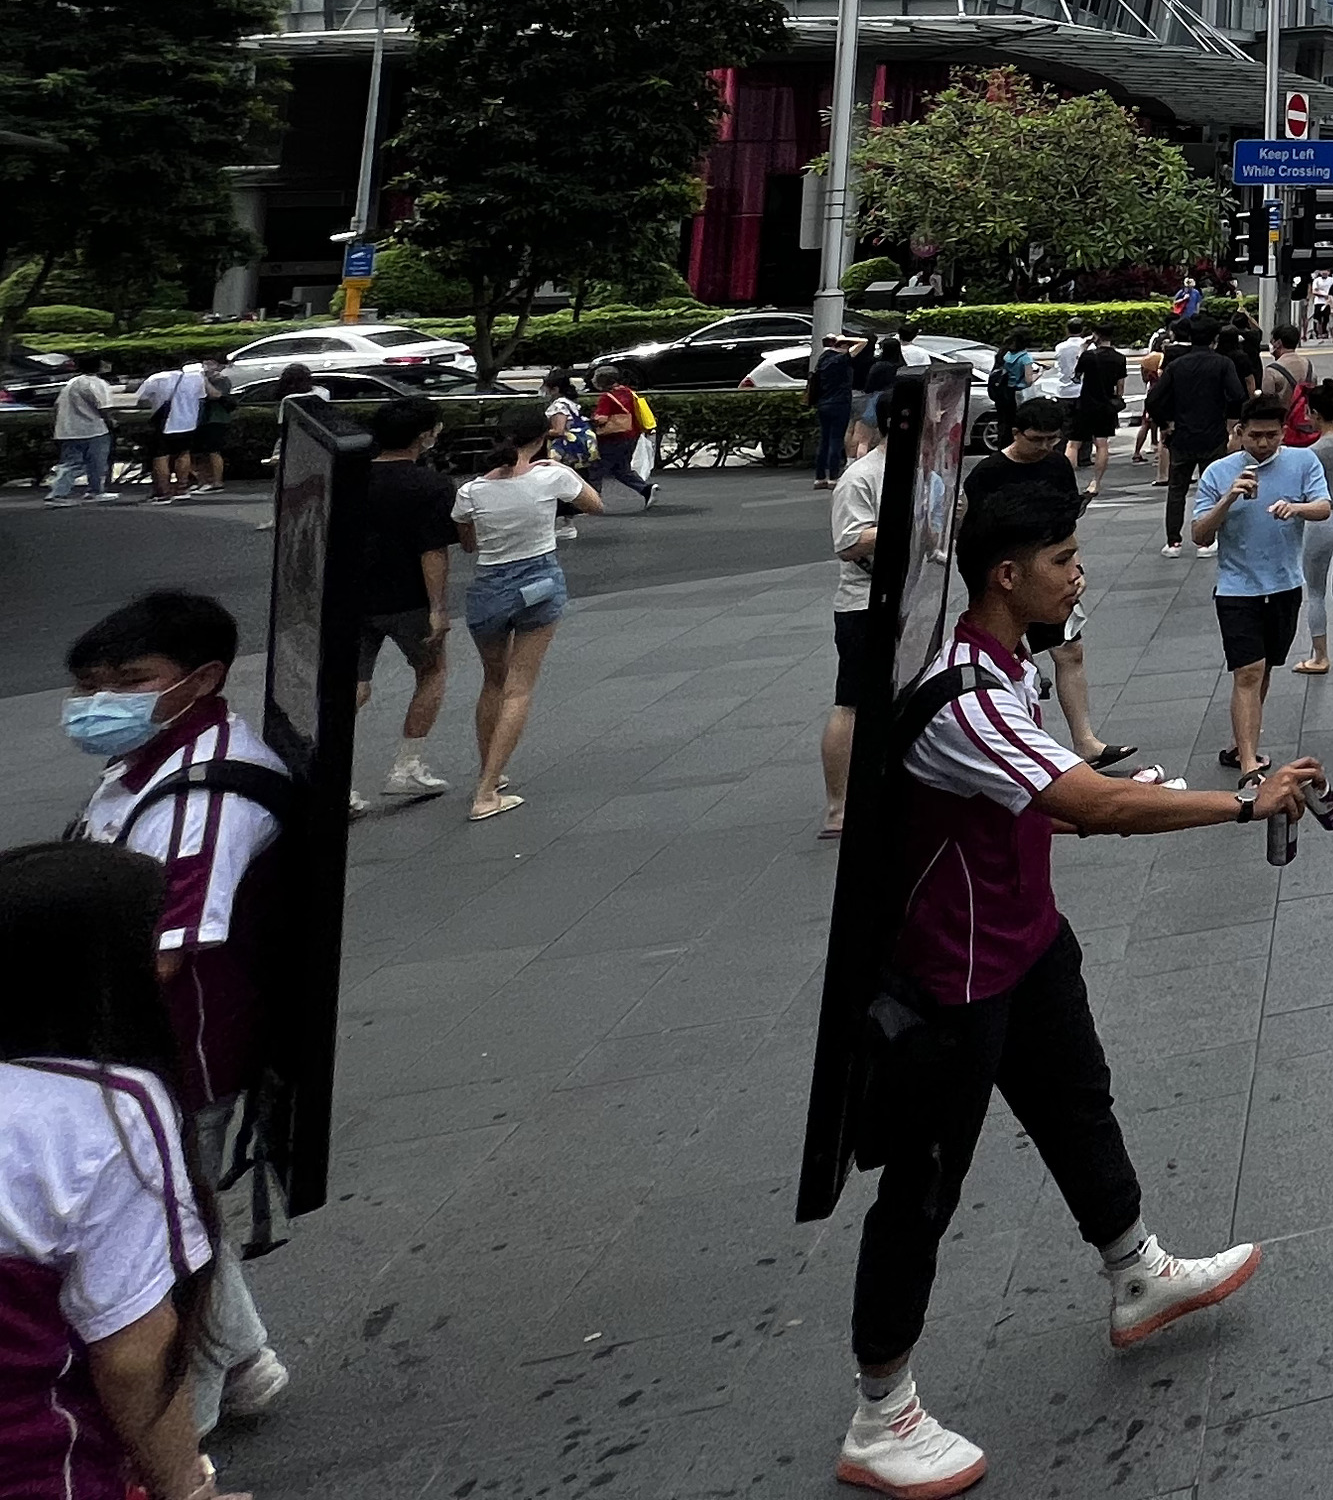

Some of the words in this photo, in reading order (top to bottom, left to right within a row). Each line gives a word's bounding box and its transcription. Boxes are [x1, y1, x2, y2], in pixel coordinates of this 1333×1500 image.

[1259, 147, 1290, 162] Keep
[1292, 148, 1315, 160] Left
[1242, 165, 1275, 177] While
[1278, 165, 1331, 180] Crossing
